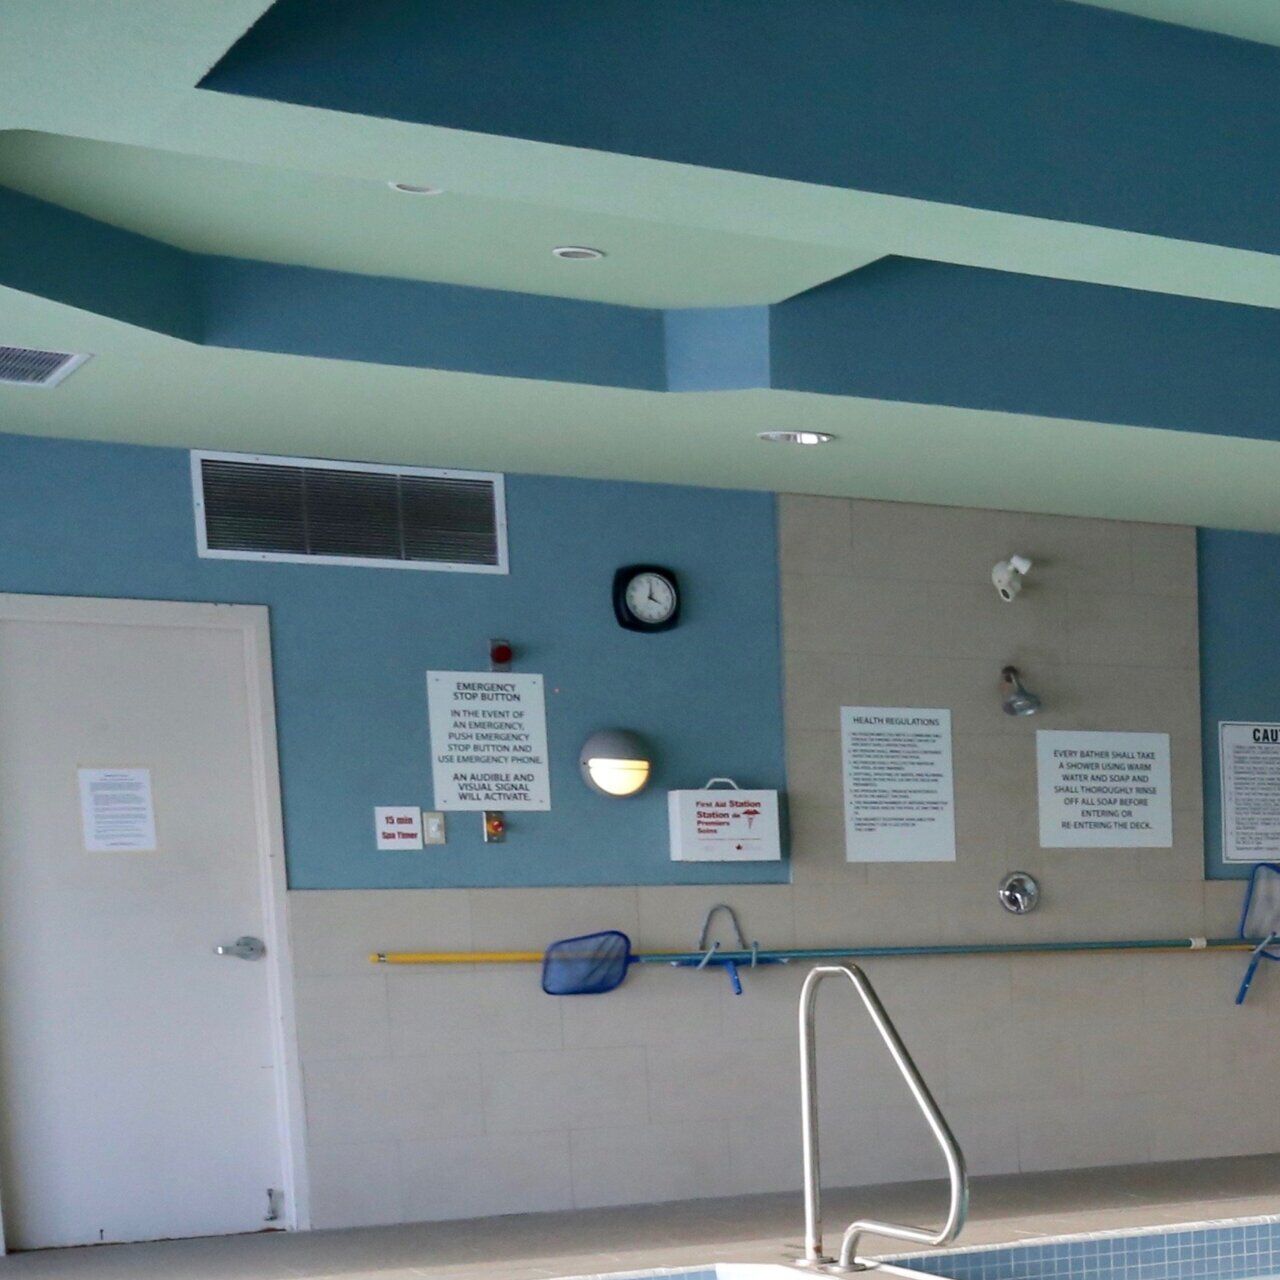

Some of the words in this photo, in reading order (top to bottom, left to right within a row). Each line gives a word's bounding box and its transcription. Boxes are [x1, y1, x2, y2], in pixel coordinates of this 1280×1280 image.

[457, 682, 516, 692] EMERGENCY
[453, 692, 478, 700] STOP
[481, 693, 521, 701] BUTTON
[463, 710, 480, 718] THE
[482, 710, 510, 718] EVENT
[512, 711, 525, 719] OF
[453, 721, 466, 729] AN
[853, 717, 884, 725] HEALTH
[886, 717, 940, 726] REGULATIONS
[448, 732, 473, 740] PUSH
[476, 733, 530, 741] EMERGENCY
[448, 744, 471, 752] STOP
[473, 744, 510, 753] BUTTON
[513, 745, 533, 753] AND
[438, 755, 454, 764] USE
[457, 756, 509, 764] EMERGENCY
[1054, 750, 1077, 758] EVERY
[1080, 750, 1109, 759] BATHER
[1111, 751, 1135, 760] SHALL
[1137, 752, 1156, 760] TAKE
[1066, 762, 1100, 770] SHOWER
[1101, 763, 1126, 771] USING
[1127, 763, 1152, 771] WARM
[453, 773, 467, 781] AN
[470, 774, 511, 782] AUDIBLE
[513, 774, 535, 782] AND
[1062, 774, 1089, 782] WATER
[1110, 775, 1131, 783] SOAP
[1132, 775, 1150, 783] AND
[459, 783, 492, 791] VISUAL
[495, 783, 530, 792] SIGNAL
[1054, 786, 1079, 794] SHALL
[1081, 786, 1134, 795] THOROUGHLY
[1135, 787, 1157, 795] RINSE
[459, 793, 481, 801] WILL
[729, 800, 761, 808] Station
[1064, 797, 1080, 806] OFF
[1081, 798, 1095, 806] ALL
[1097, 798, 1118, 806] SOAP
[1120, 798, 1149, 807] BEFORE
[697, 811, 730, 819] Station
[1081, 810, 1120, 818] ENTERING
[1121, 810, 1133, 818] OR
[385, 816, 395, 825] 15
[397, 816, 413, 825] min
[1114, 822, 1128, 830] THE
[382, 832, 396, 840] Spa
[397, 832, 418, 840] Timer
